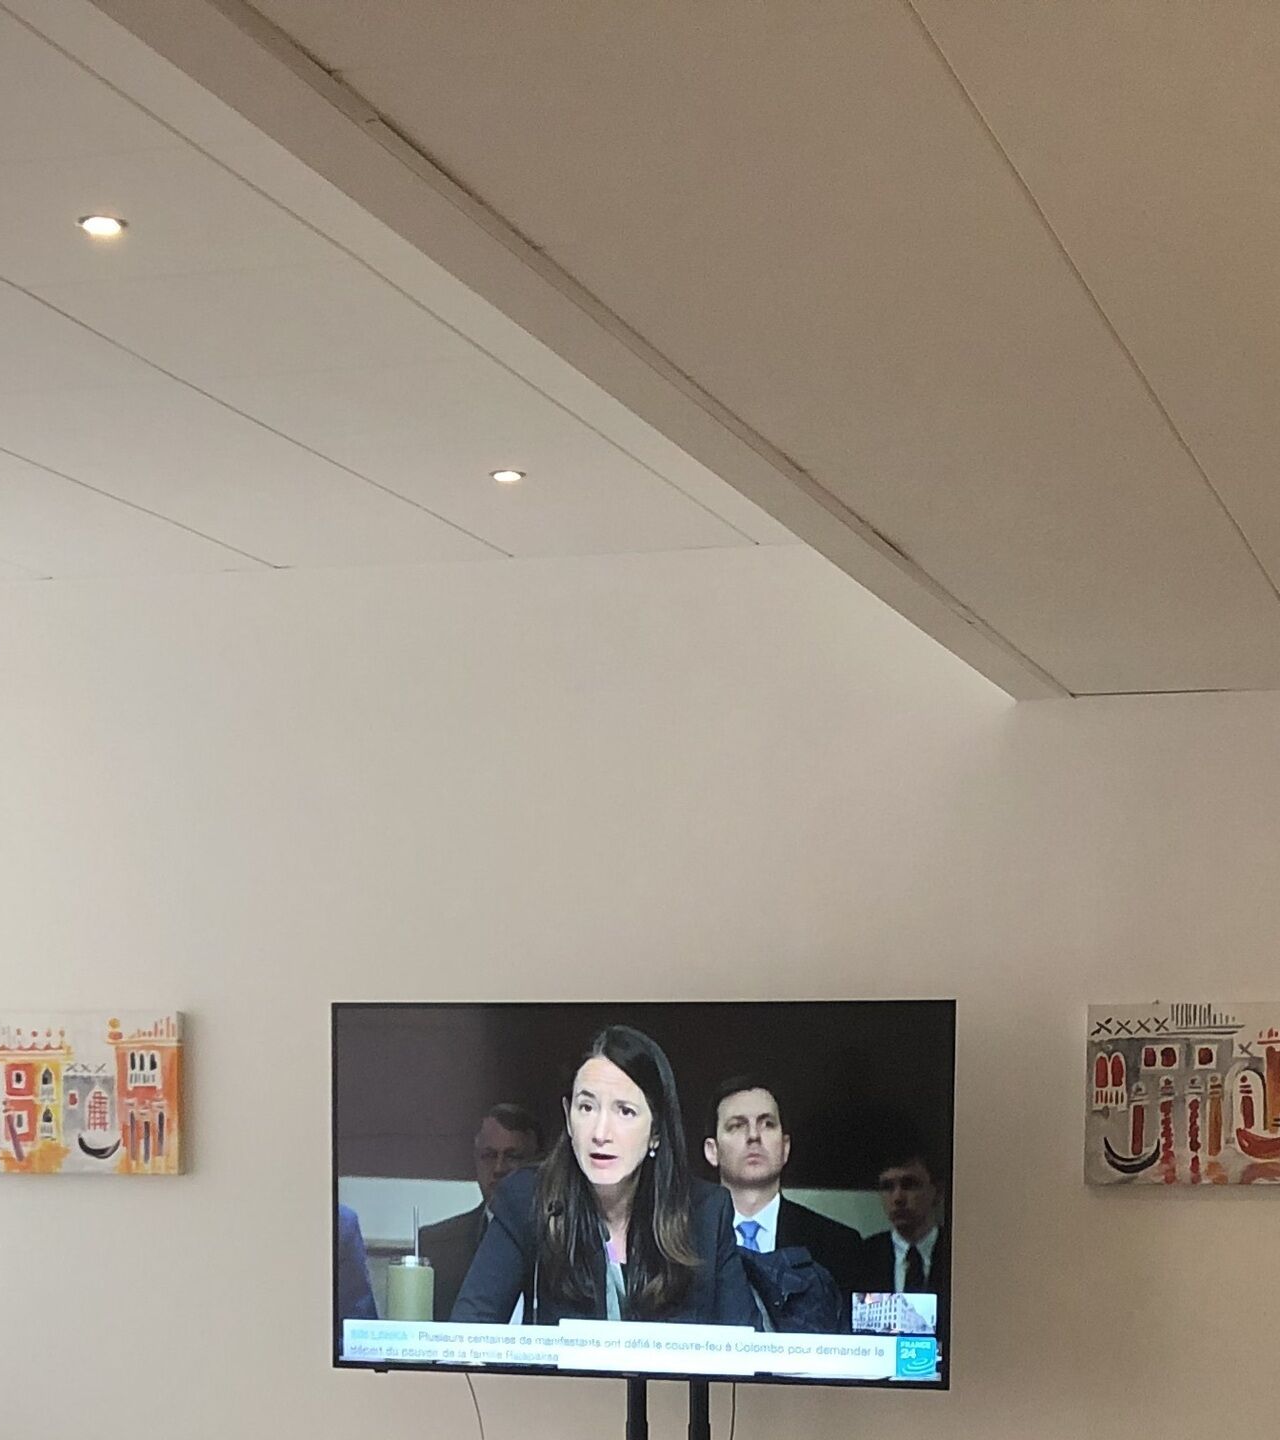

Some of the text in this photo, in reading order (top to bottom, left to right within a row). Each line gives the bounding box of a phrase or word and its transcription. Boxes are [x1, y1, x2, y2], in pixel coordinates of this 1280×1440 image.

[418, 1331, 464, 1343] Plusieurs
[467, 1335, 516, 1345] centaines
[519, 1336, 532, 1345] de
[604, 1339, 621, 1348] ont
[653, 1340, 662, 1350] le
[734, 1342, 784, 1354] Colombo
[787, 1345, 812, 1355] pour
[815, 1344, 871, 1357] demander
[874, 1346, 885, 1357] le
[900, 1341, 932, 1349] FRANCE
[900, 1348, 917, 1359] 24
